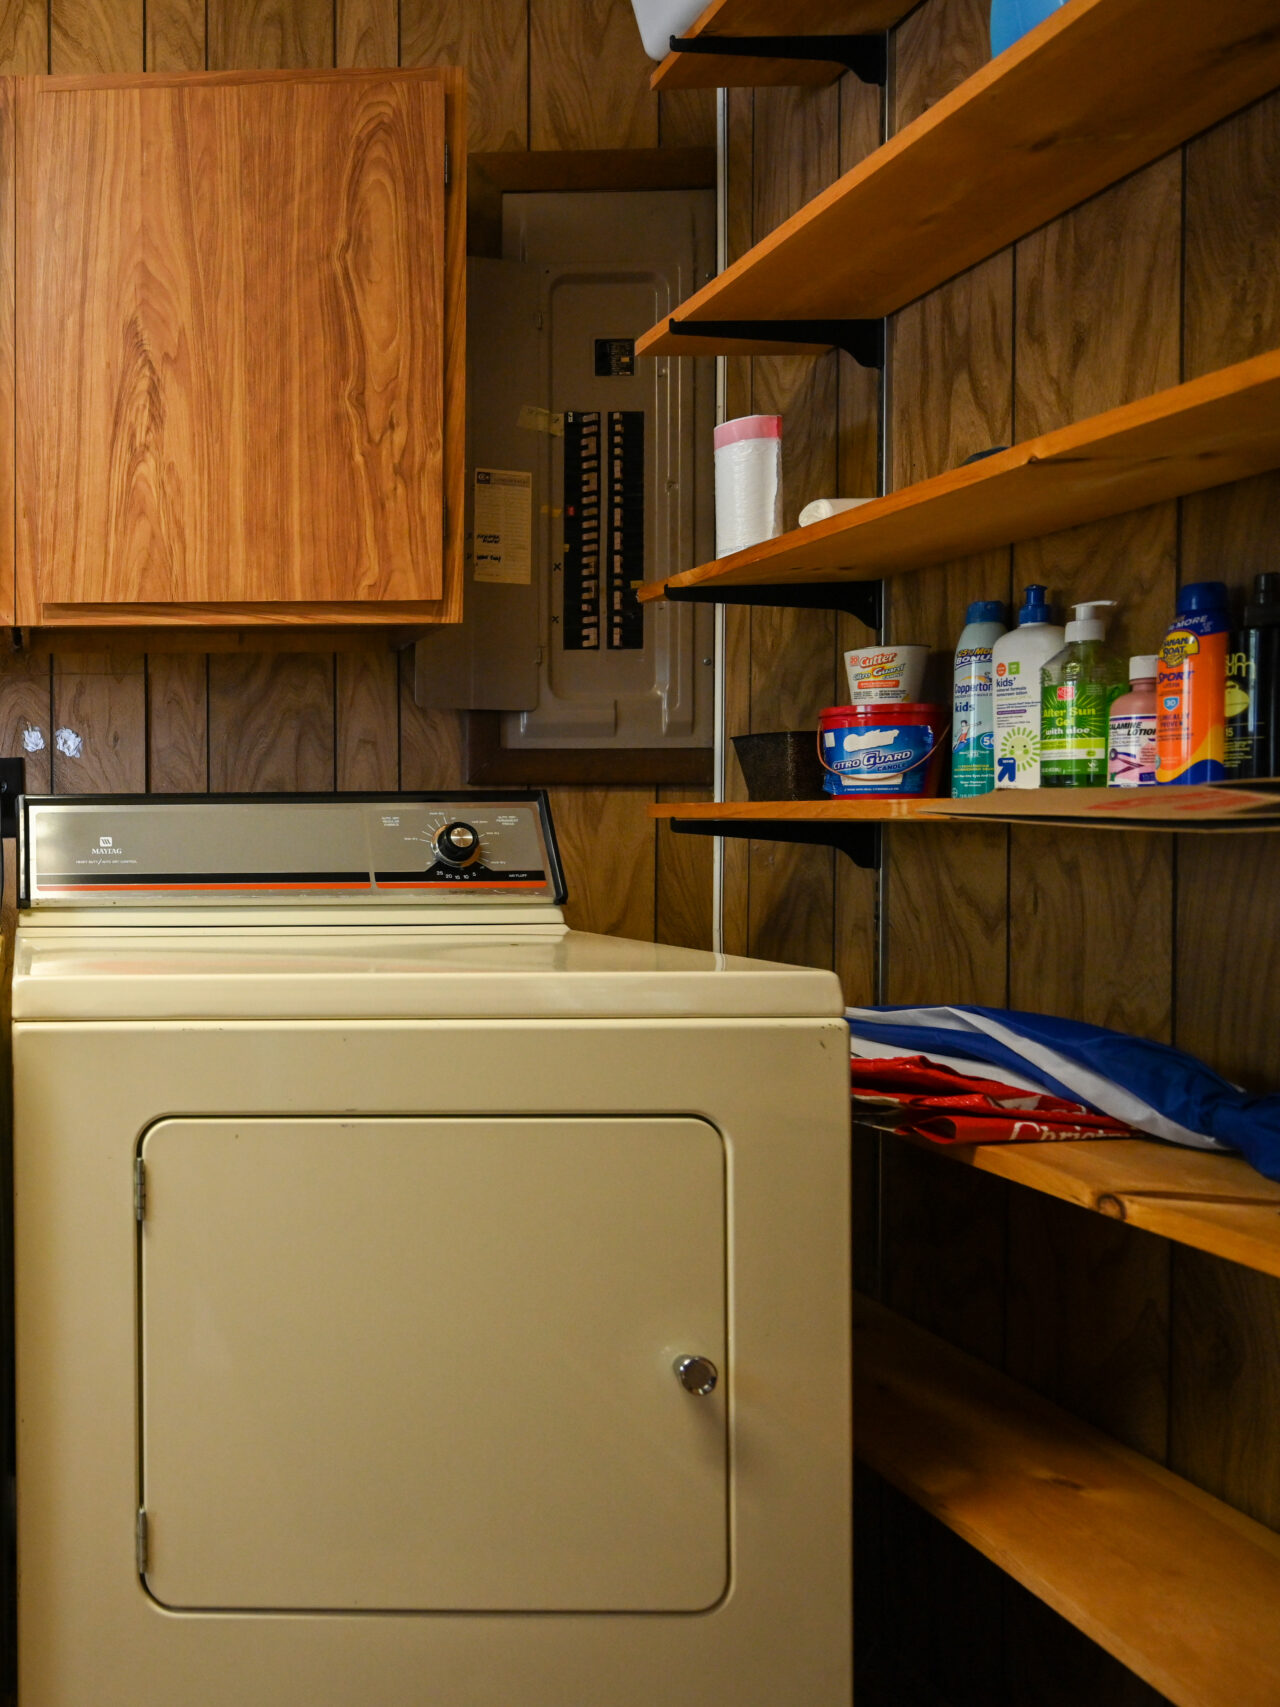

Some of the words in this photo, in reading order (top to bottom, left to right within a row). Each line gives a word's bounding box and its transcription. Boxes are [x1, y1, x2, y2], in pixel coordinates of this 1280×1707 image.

[860, 652, 898, 668] Cutter
[1225, 652, 1247, 665] un
[955, 702, 976, 712] kids
[1070, 707, 1097, 716] Sun
[1056, 718, 1076, 727] Gel
[1110, 722, 1143, 730] ALAMINE
[833, 759, 861, 770] CITRO
[862, 750, 913, 768] GUARD
